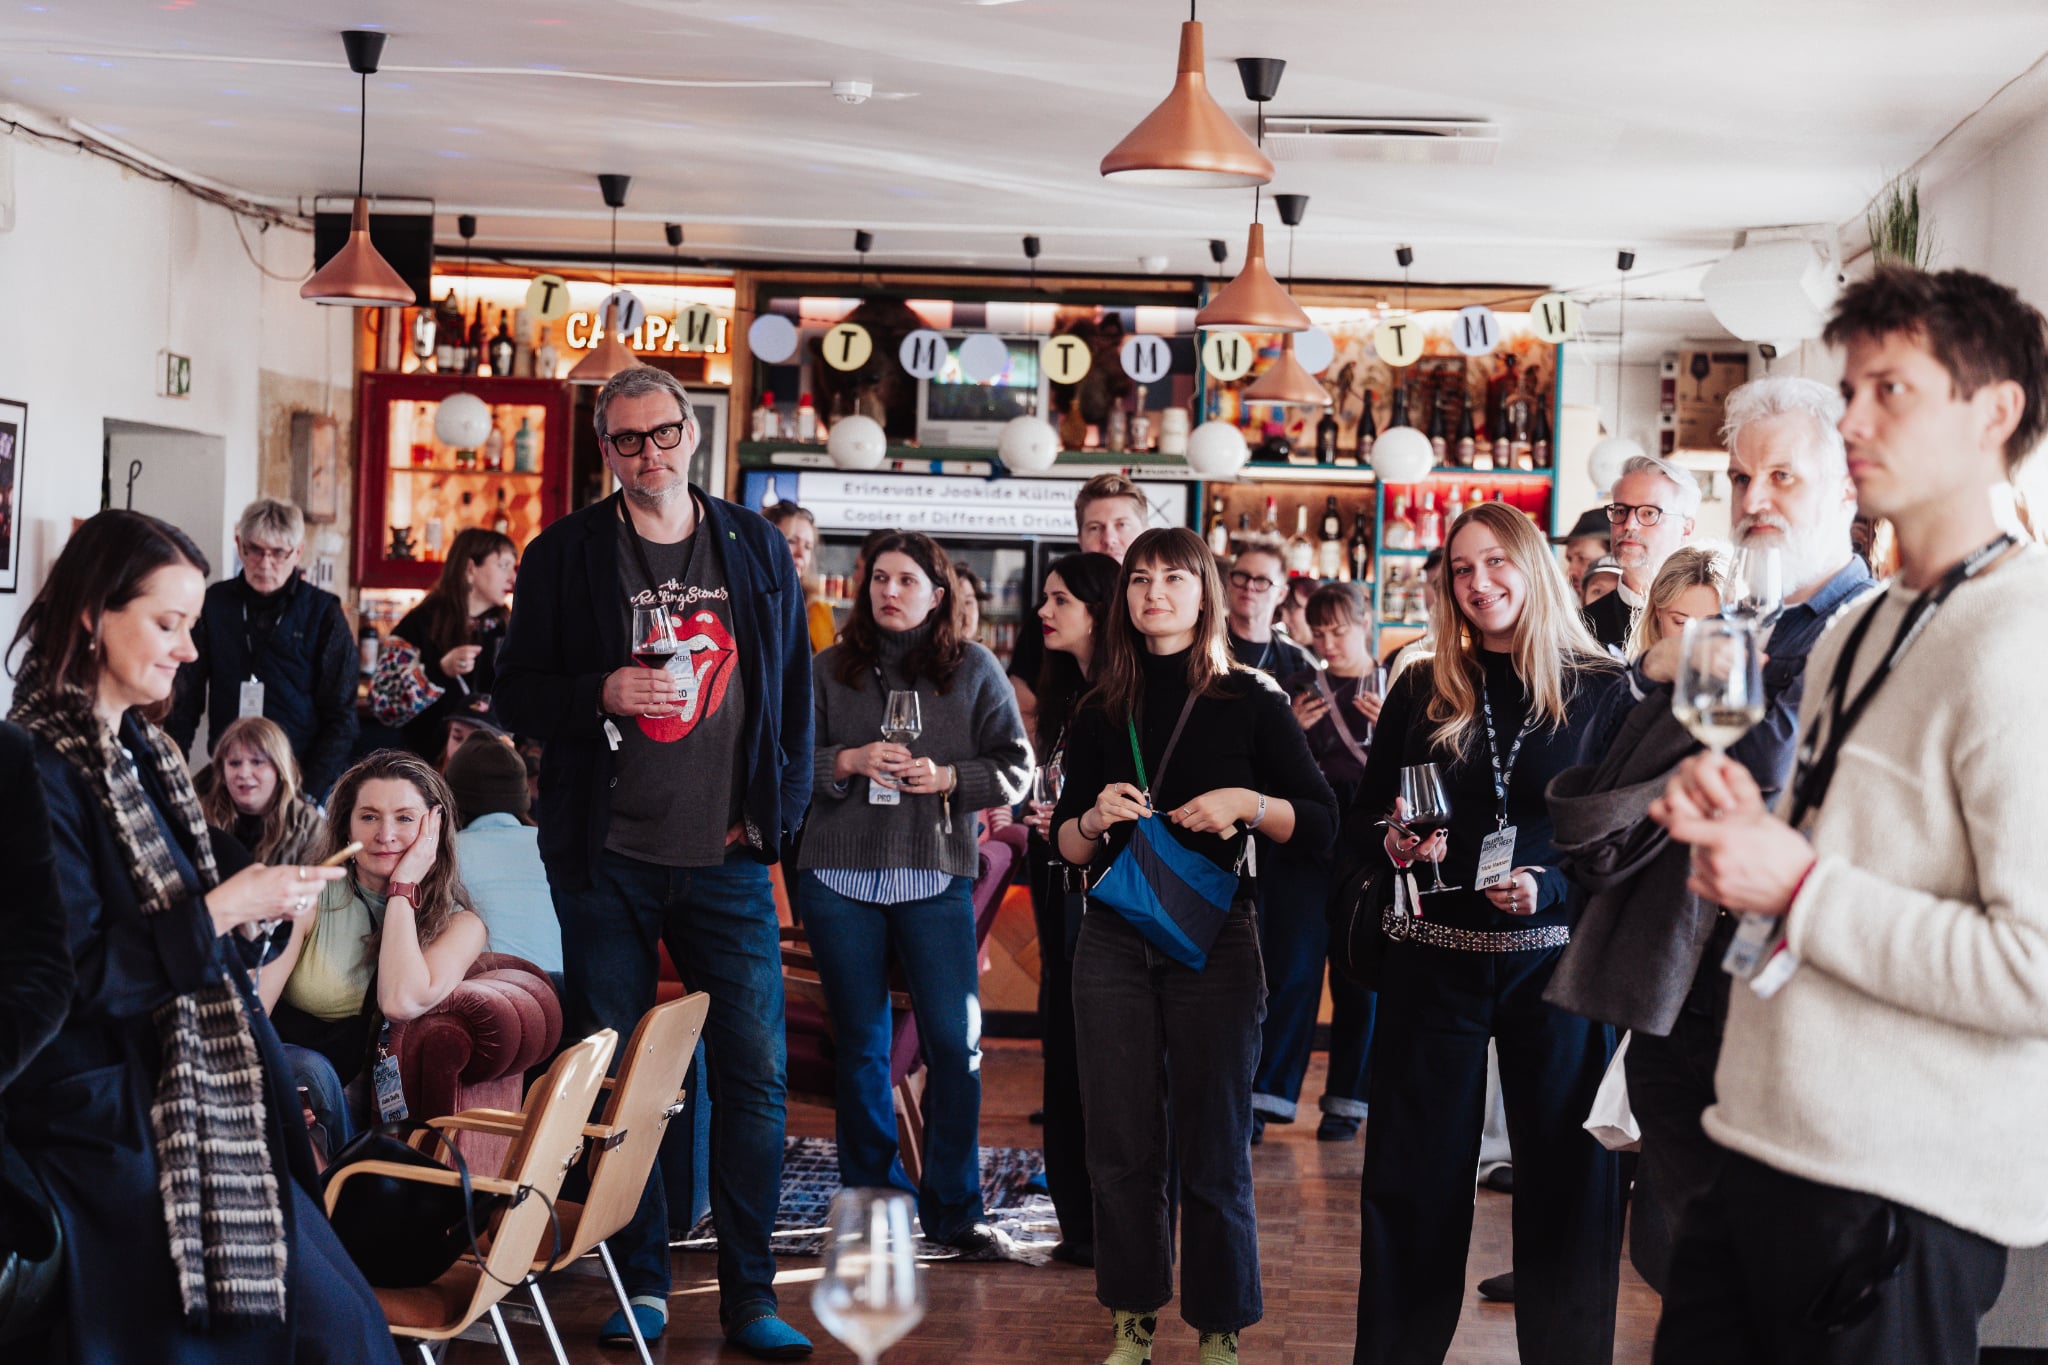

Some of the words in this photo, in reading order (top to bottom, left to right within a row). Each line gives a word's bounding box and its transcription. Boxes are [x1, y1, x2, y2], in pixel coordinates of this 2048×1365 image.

[542, 281, 559, 314] T
[687, 310, 710, 344] W
[566, 312, 728, 353] CAPAI
[1389, 324, 1407, 357] T
[1465, 314, 1488, 348] M
[1543, 301, 1566, 334] W
[840, 330, 857, 362] T
[913, 337, 936, 371] M
[1057, 343, 1074, 376] T
[1135, 342, 1157, 374] M
[1216, 339, 1238, 371] W
[843, 482, 935, 497] Erinevate
[940, 484, 1012, 499] Jookide
[1019, 486, 1073, 501] Külmi
[843, 508, 903, 522] Cooler
[908, 510, 926, 523] of
[931, 511, 1016, 527] Different
[1021, 514, 1073, 529] Drink
[685, 586, 728, 603] Stones
[876, 794, 892, 802] PRO
[1483, 874, 1500, 886] PRO
[388, 1110, 402, 1121] PRO
